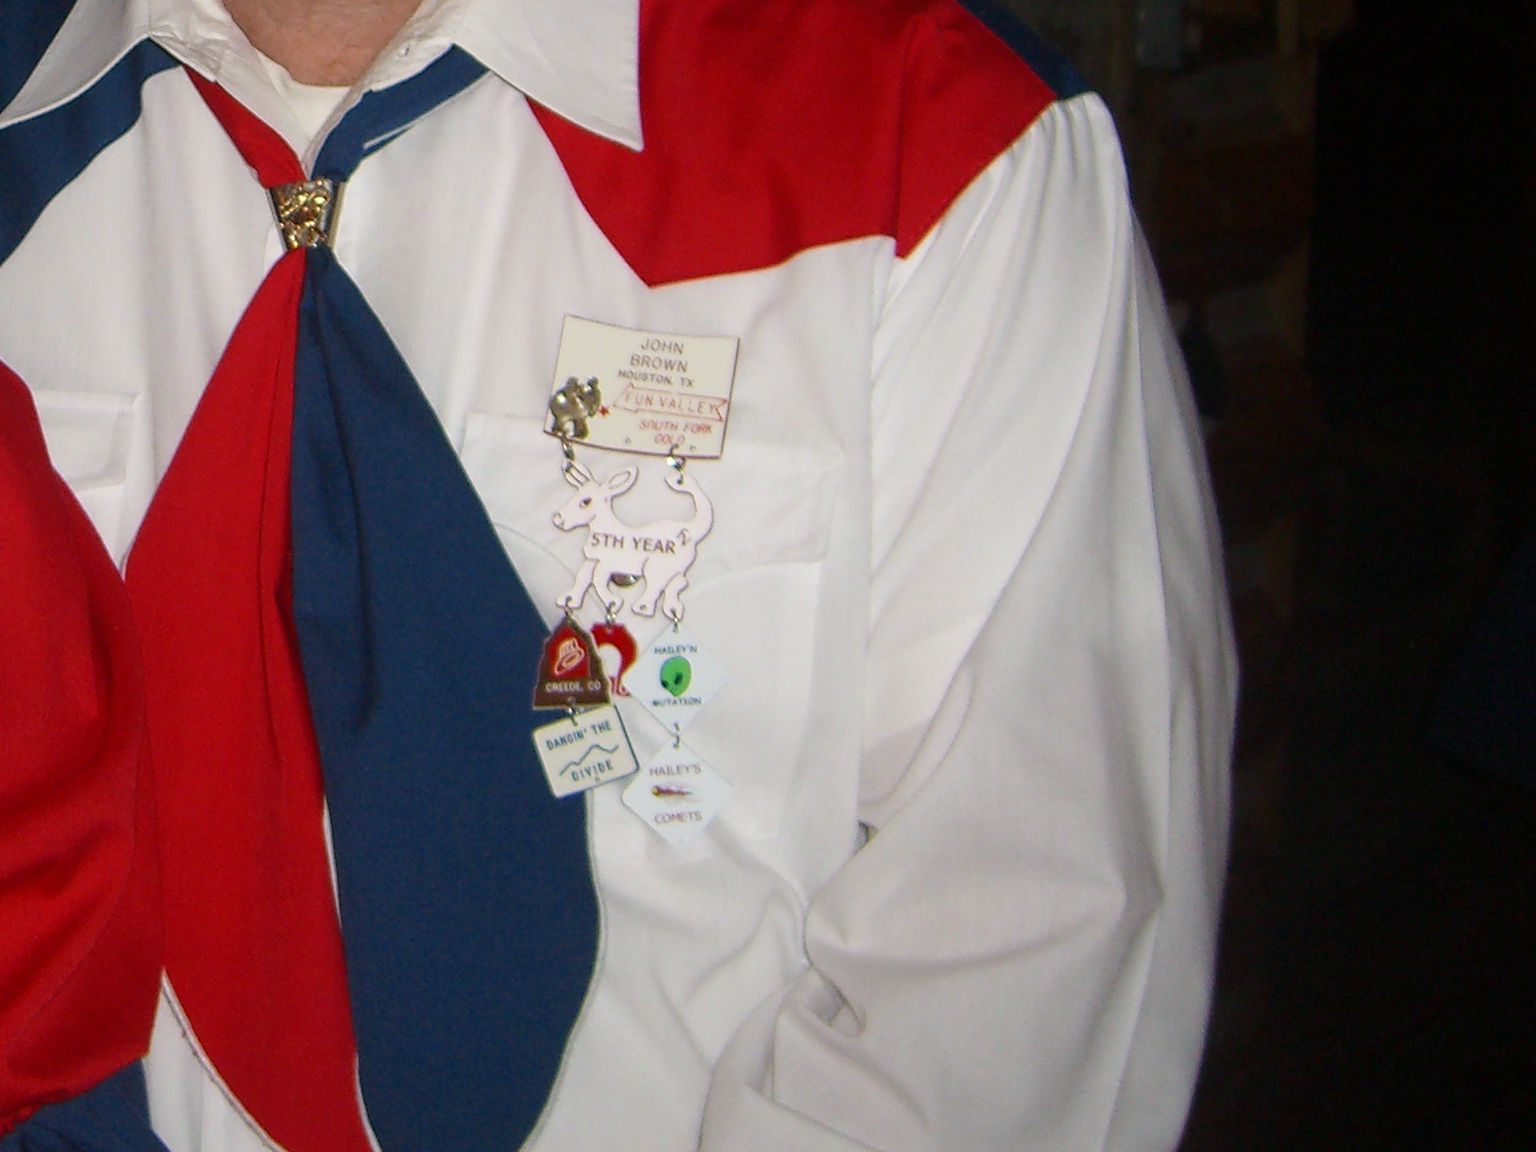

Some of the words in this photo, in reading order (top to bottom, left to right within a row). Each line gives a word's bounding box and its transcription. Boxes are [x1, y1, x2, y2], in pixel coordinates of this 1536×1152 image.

[640, 338, 684, 355] JOHN
[630, 354, 688, 373] BROWN
[680, 376, 695, 388] TX
[624, 391, 654, 407] FUN
[659, 396, 717, 415] VALLEY
[639, 419, 680, 432] SOUTH
[684, 422, 713, 435] FORK
[590, 532, 624, 550] 5TH
[631, 534, 677, 555] YEAR
[587, 679, 602, 691] CO
[652, 697, 702, 707] MUTATION
[545, 728, 588, 751] DANCIN'
[590, 719, 613, 735] THE
[570, 759, 614, 783] DIVIDE
[649, 762, 702, 777] HAILEY'S
[653, 810, 703, 825] COMETS
